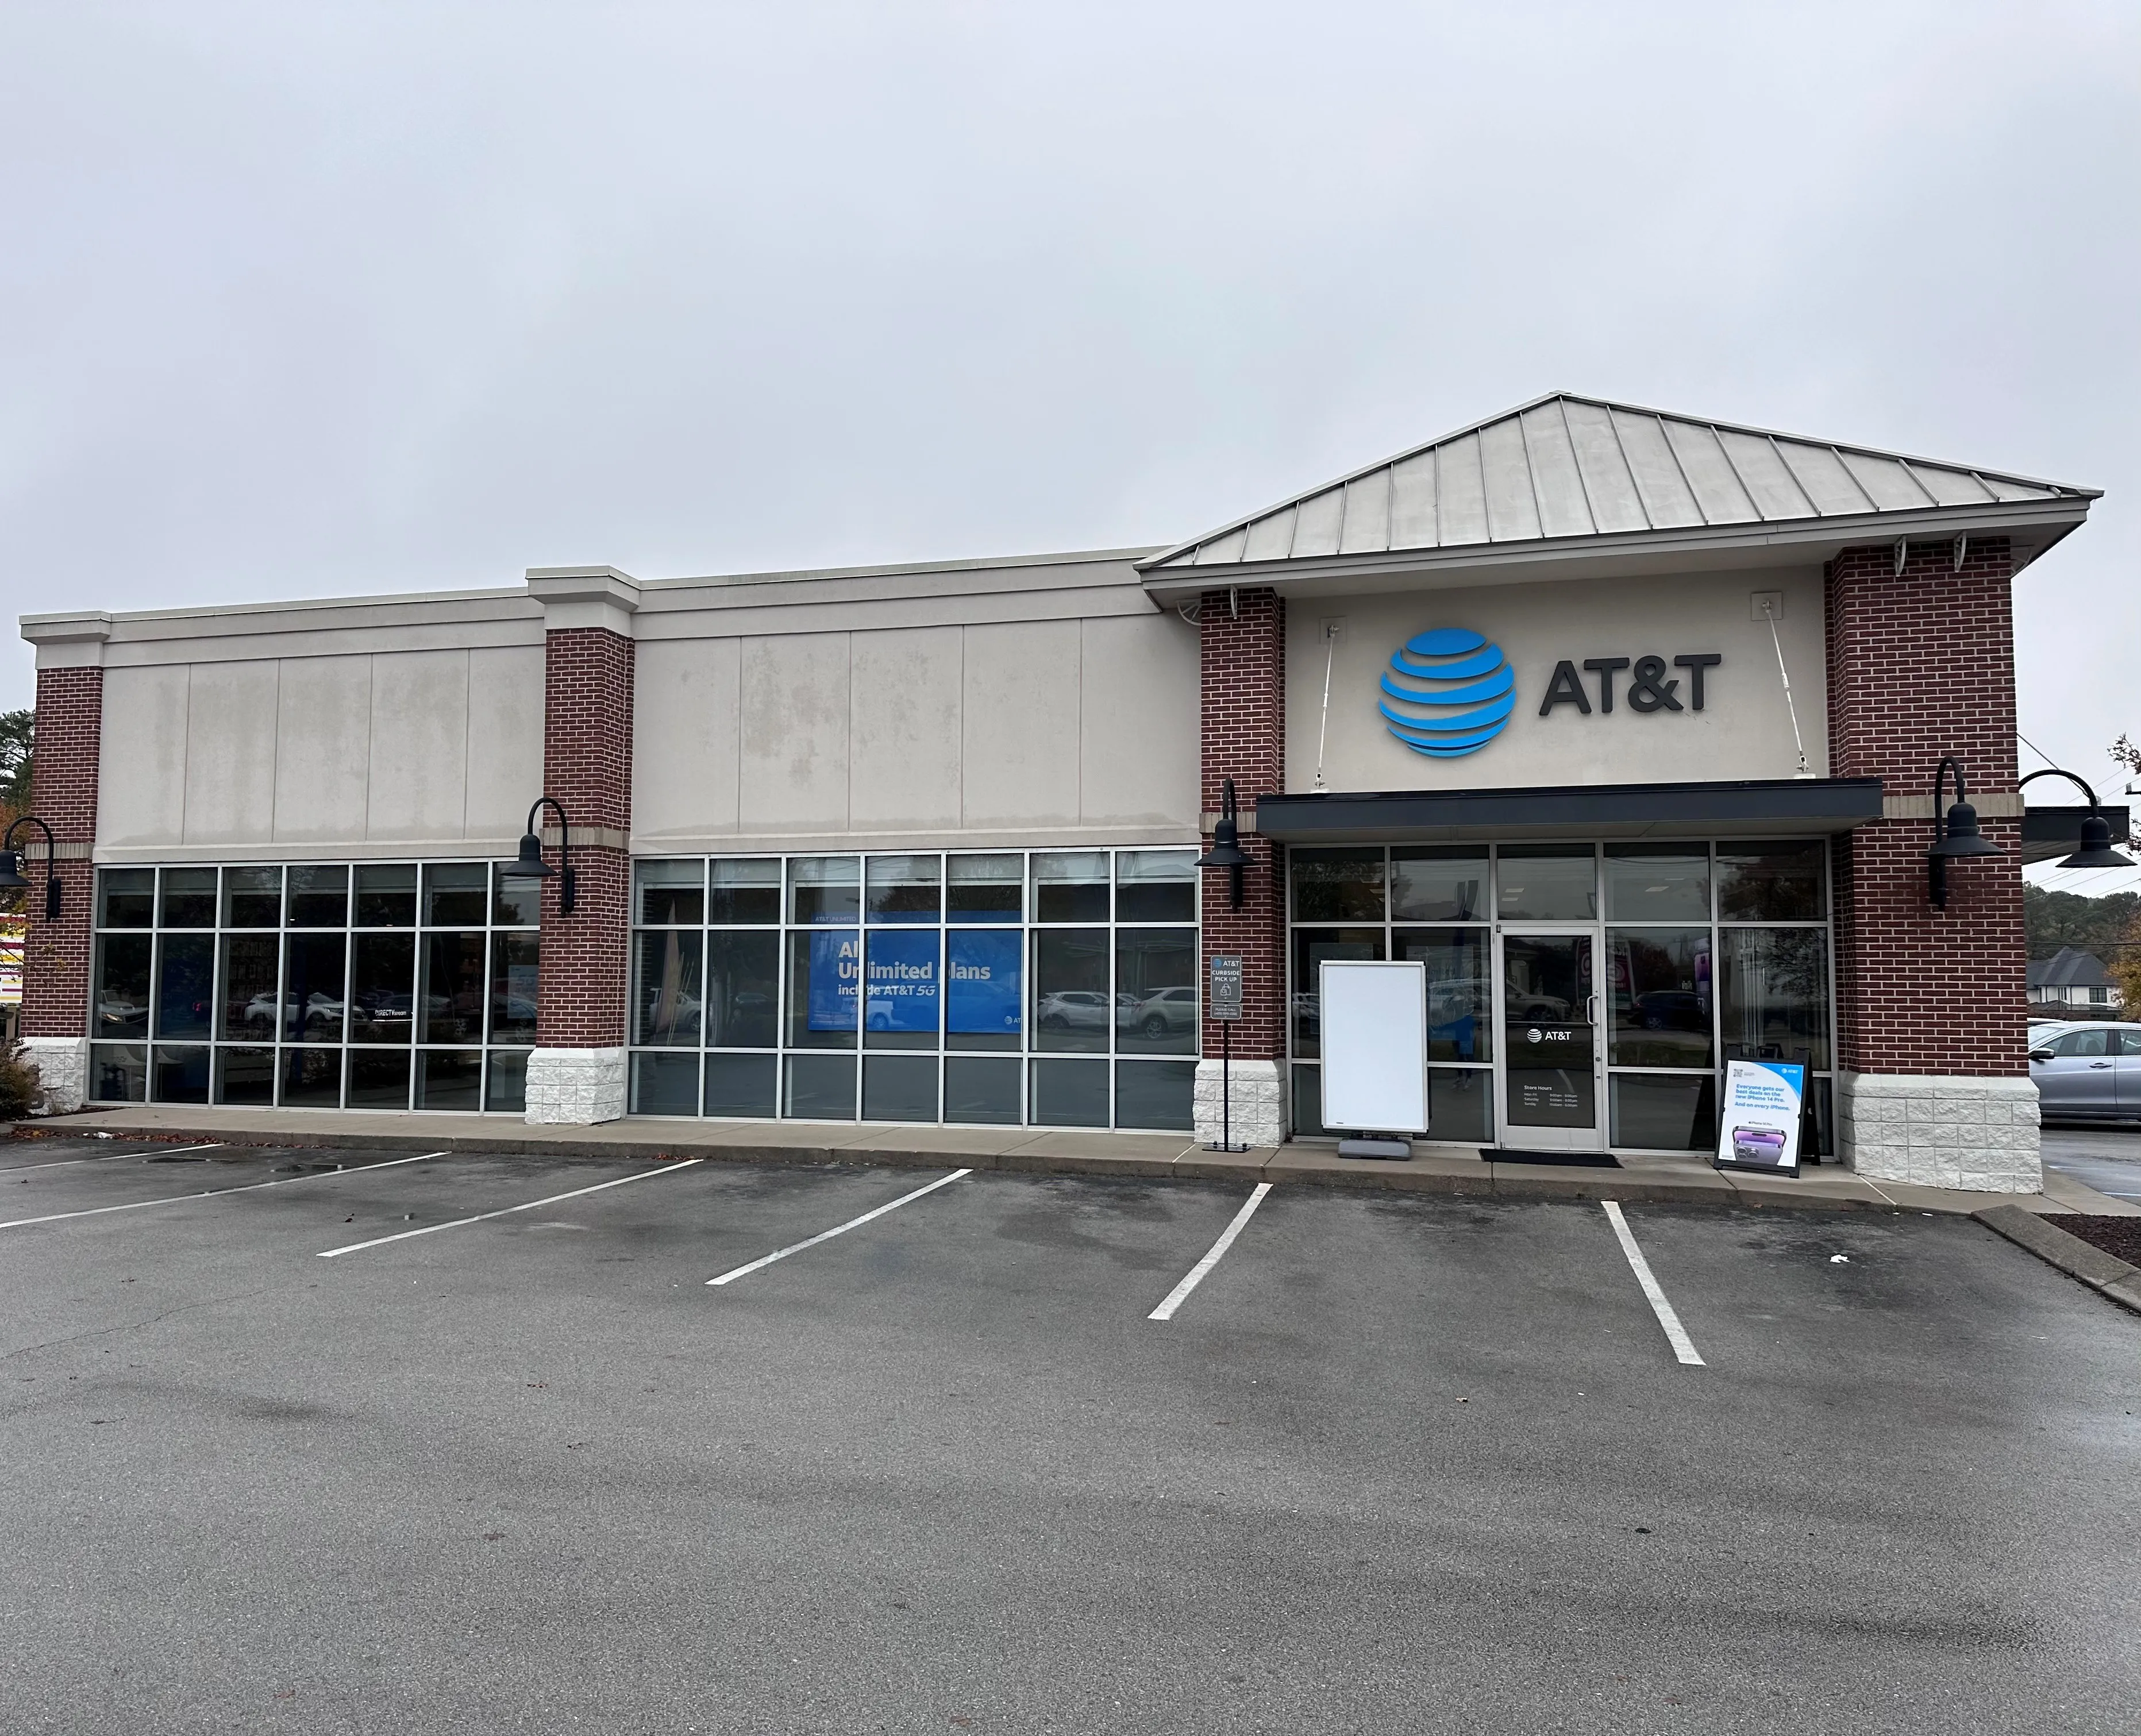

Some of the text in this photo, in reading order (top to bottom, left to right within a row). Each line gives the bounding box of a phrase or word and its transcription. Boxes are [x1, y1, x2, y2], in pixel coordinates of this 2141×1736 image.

[1539, 653, 1722, 716] AT&T
[838, 940, 859, 958] Al
[838, 984, 936, 996] inclde AT&T 5G
[1545, 1031, 1572, 1040] AT&T
